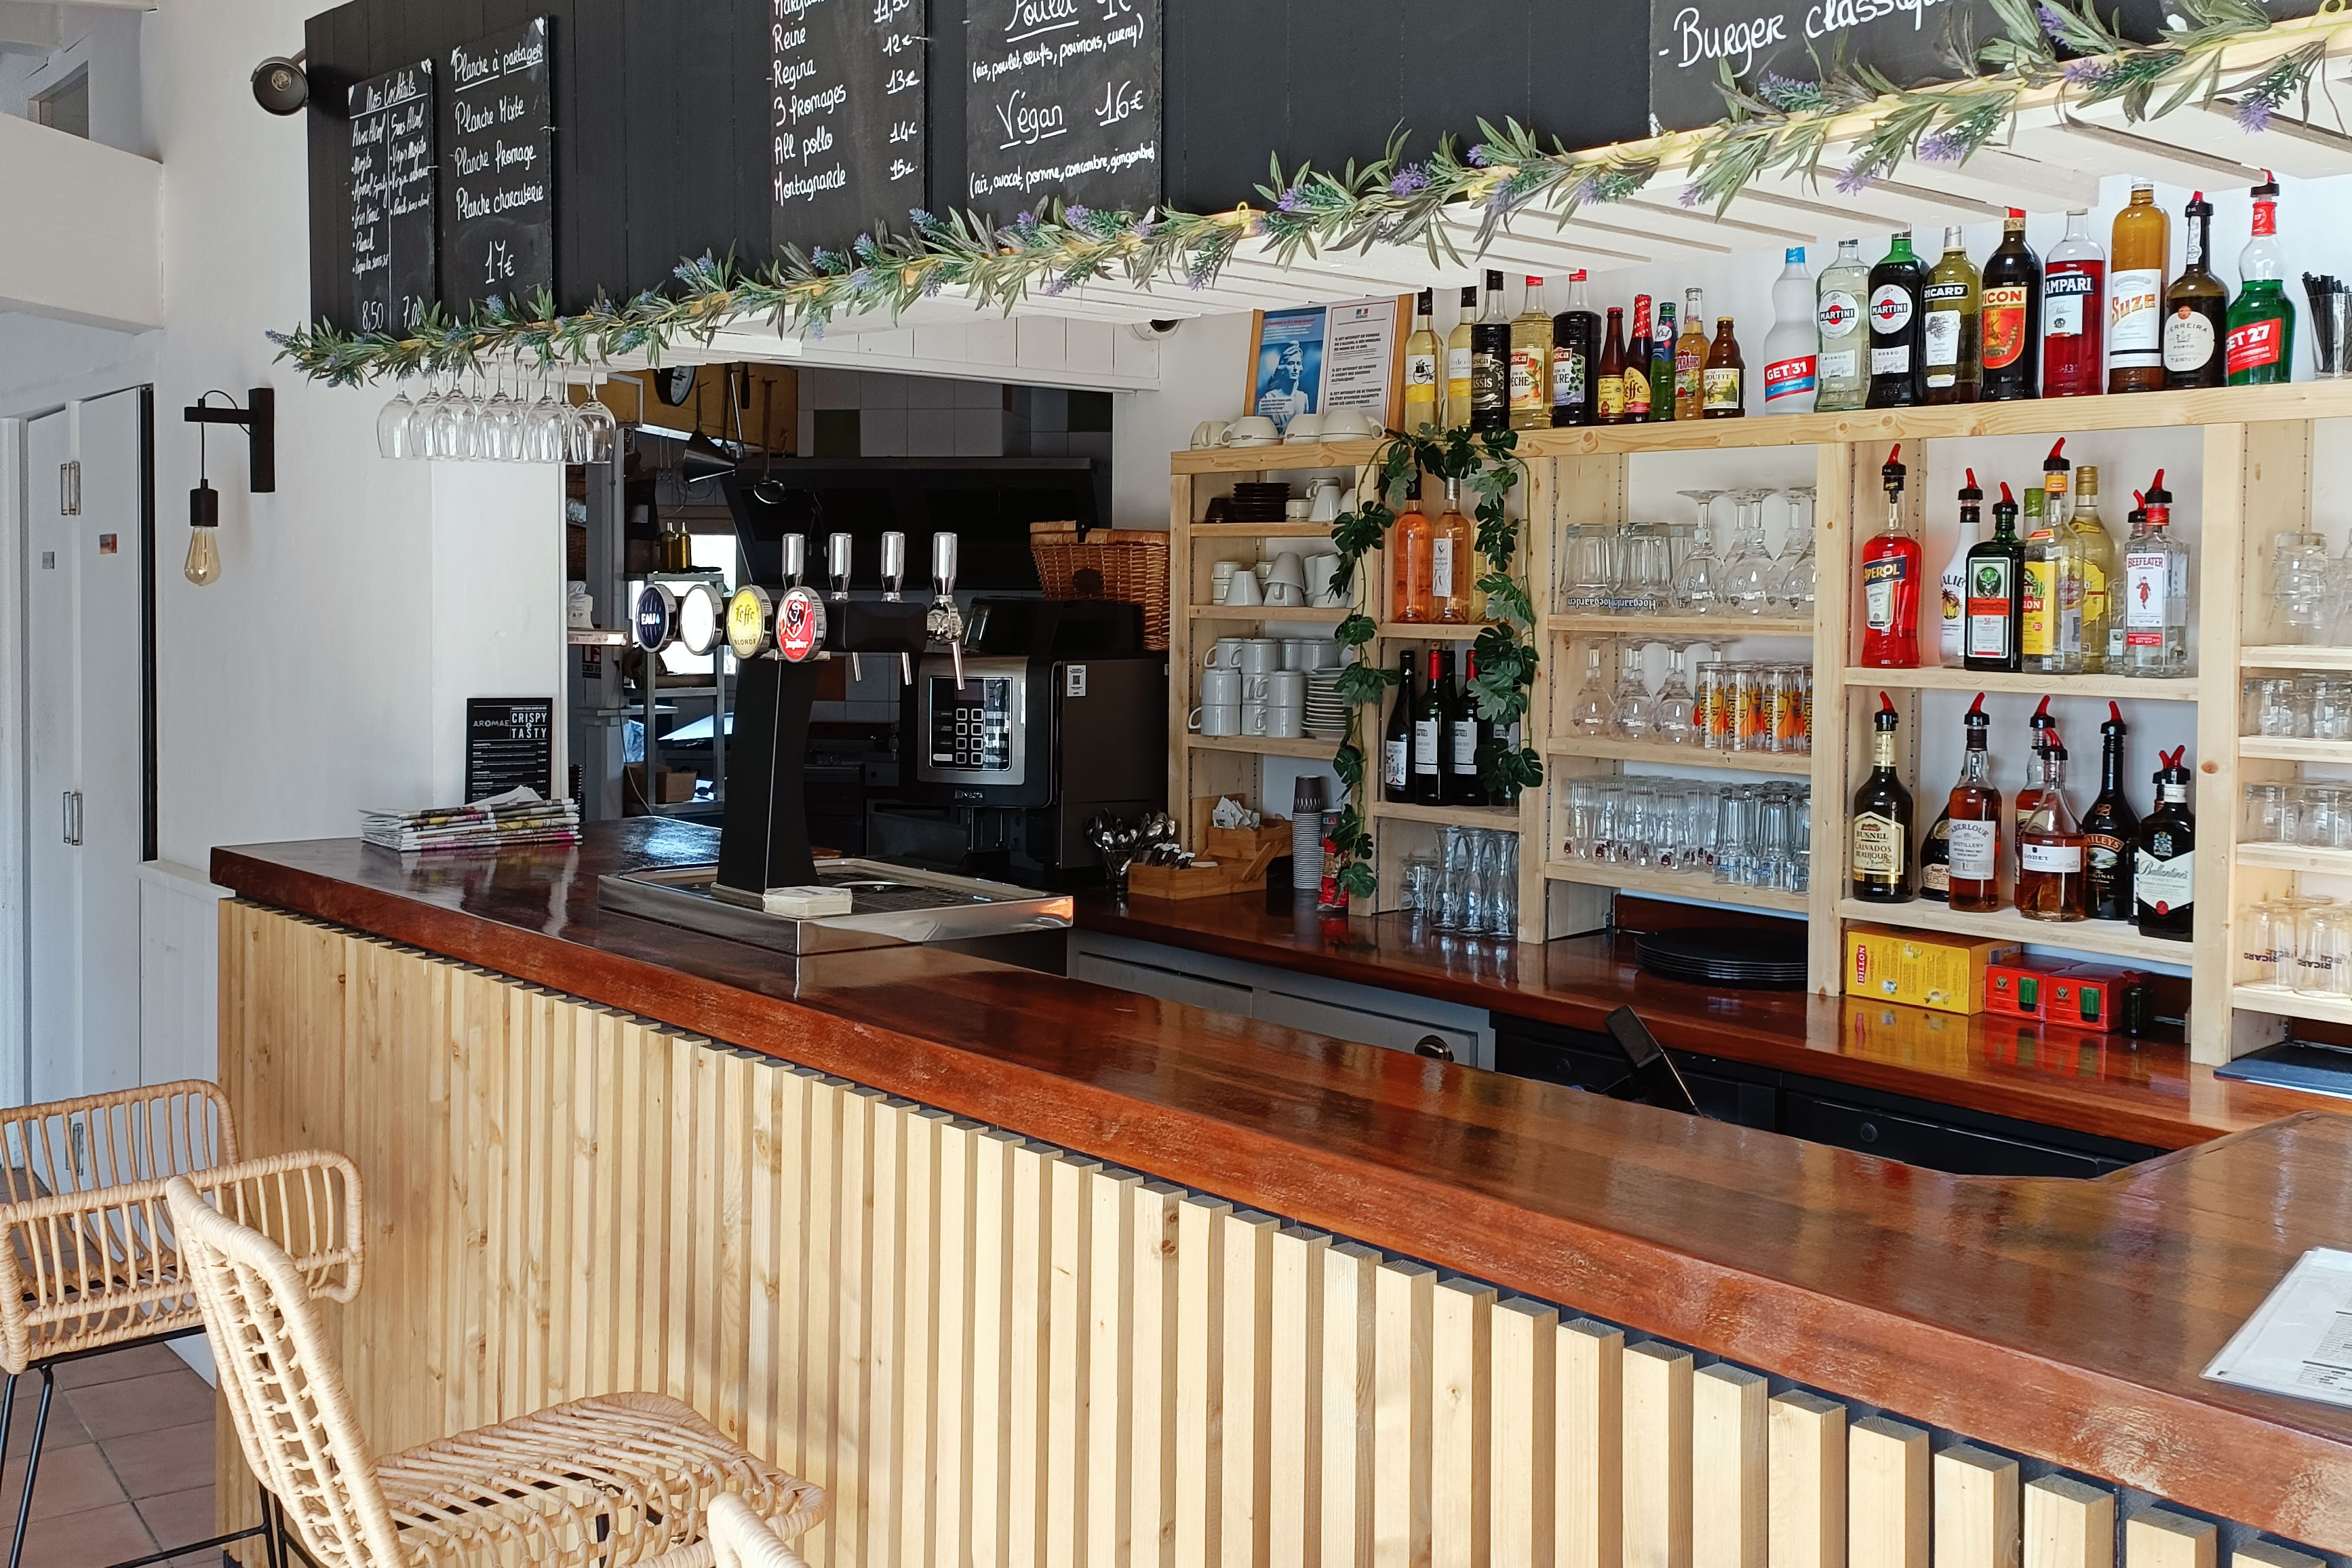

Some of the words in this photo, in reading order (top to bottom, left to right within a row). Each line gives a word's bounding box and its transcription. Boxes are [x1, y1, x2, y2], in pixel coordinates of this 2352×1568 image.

[772, 22, 806, 54] Reine
[1674, 7, 1786, 78] Burger
[454, 52, 489, 81] Planche
[492, 48, 499, 72] à
[773, 56, 817, 91] Regina
[455, 101, 494, 136] Planche
[499, 94, 525, 123] Mixte
[773, 96, 787, 127] 3
[789, 83, 847, 125] fromages
[996, 90, 1063, 144] Végan
[1095, 81, 1143, 126] 16€
[775, 132, 796, 165] All
[802, 125, 833, 168] pollo
[455, 146, 490, 177] Planche
[495, 140, 536, 174] fromage
[774, 162, 846, 207] Montagnarde
[456, 187, 490, 221] Planche
[493, 180, 544, 214] charcuterie
[1924, 286, 1964, 298] RICARD
[2045, 278, 2092, 294] AMPARI
[362, 300, 384, 332] 8,50
[1820, 309, 1854, 320] MARTINI
[1872, 304, 1906, 315] MARTINI
[2112, 293, 2155, 326] Suze
[2247, 324, 2271, 341] 27
[1767, 364, 1790, 380] GET
[1791, 361, 1807, 374] 31
[1472, 378, 1493, 389] ASSIS
[2128, 557, 2163, 568] BEEFEATER
[641, 613, 656, 625] EAU
[735, 604, 756, 625] Leffe
[511, 712, 547, 724] CRISPY
[511, 728, 547, 739] TASTY
[1856, 831, 1889, 840] BUSNEL
[1951, 823, 1989, 838] ABERLOUR
[1854, 842, 1892, 852] CALVADOS
[2086, 835, 2120, 849] AILEYS
[2140, 859, 2188, 880] Ballantine's
